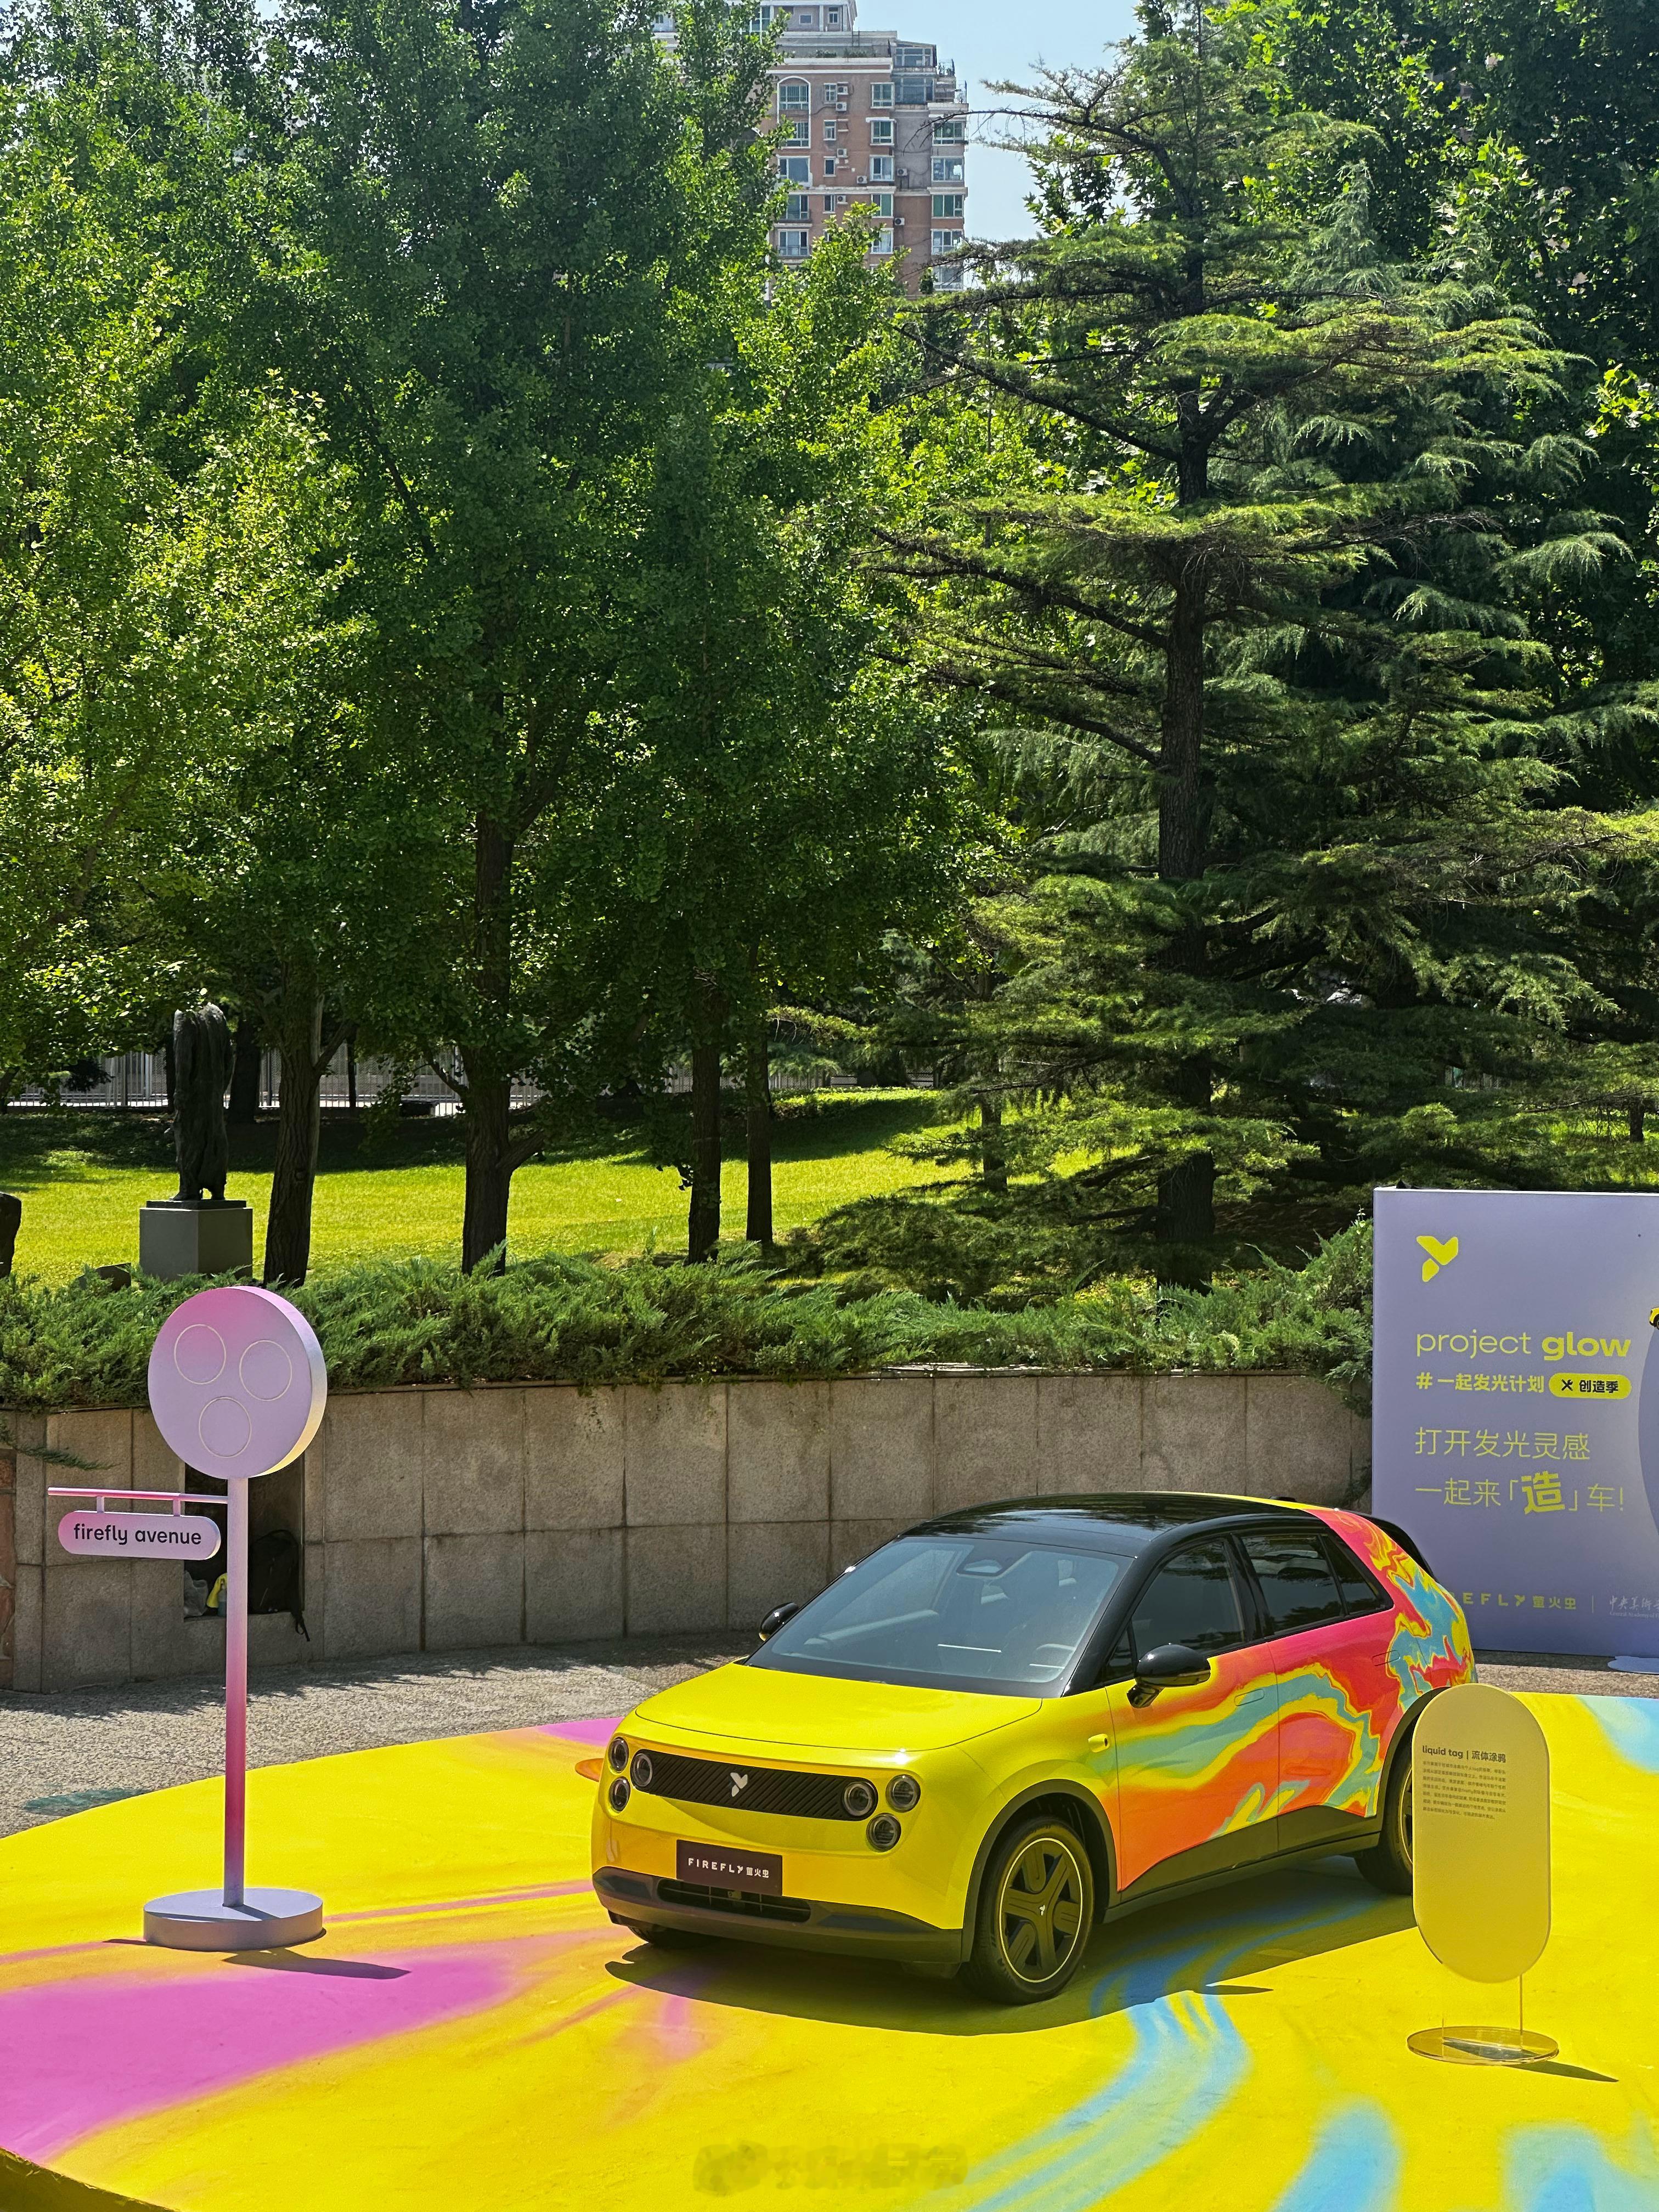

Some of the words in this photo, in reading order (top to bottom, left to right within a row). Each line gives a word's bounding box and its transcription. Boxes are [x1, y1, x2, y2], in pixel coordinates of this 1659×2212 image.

[1416, 1329, 1531, 1359] project
[1542, 1331, 1631, 1361] glow
[1579, 1380, 1618, 1393] 创造季
[1415, 1427, 1590, 1460] 打开发光灵感
[73, 1523, 128, 1545] firefly
[135, 1528, 202, 1545] avenue
[1423, 1745, 1446, 1756] liquid
[1448, 1749, 1463, 1759] tag
[1472, 1750, 1506, 1763] 流体涂鸦
[687, 1858, 743, 1874] FIREFLY
